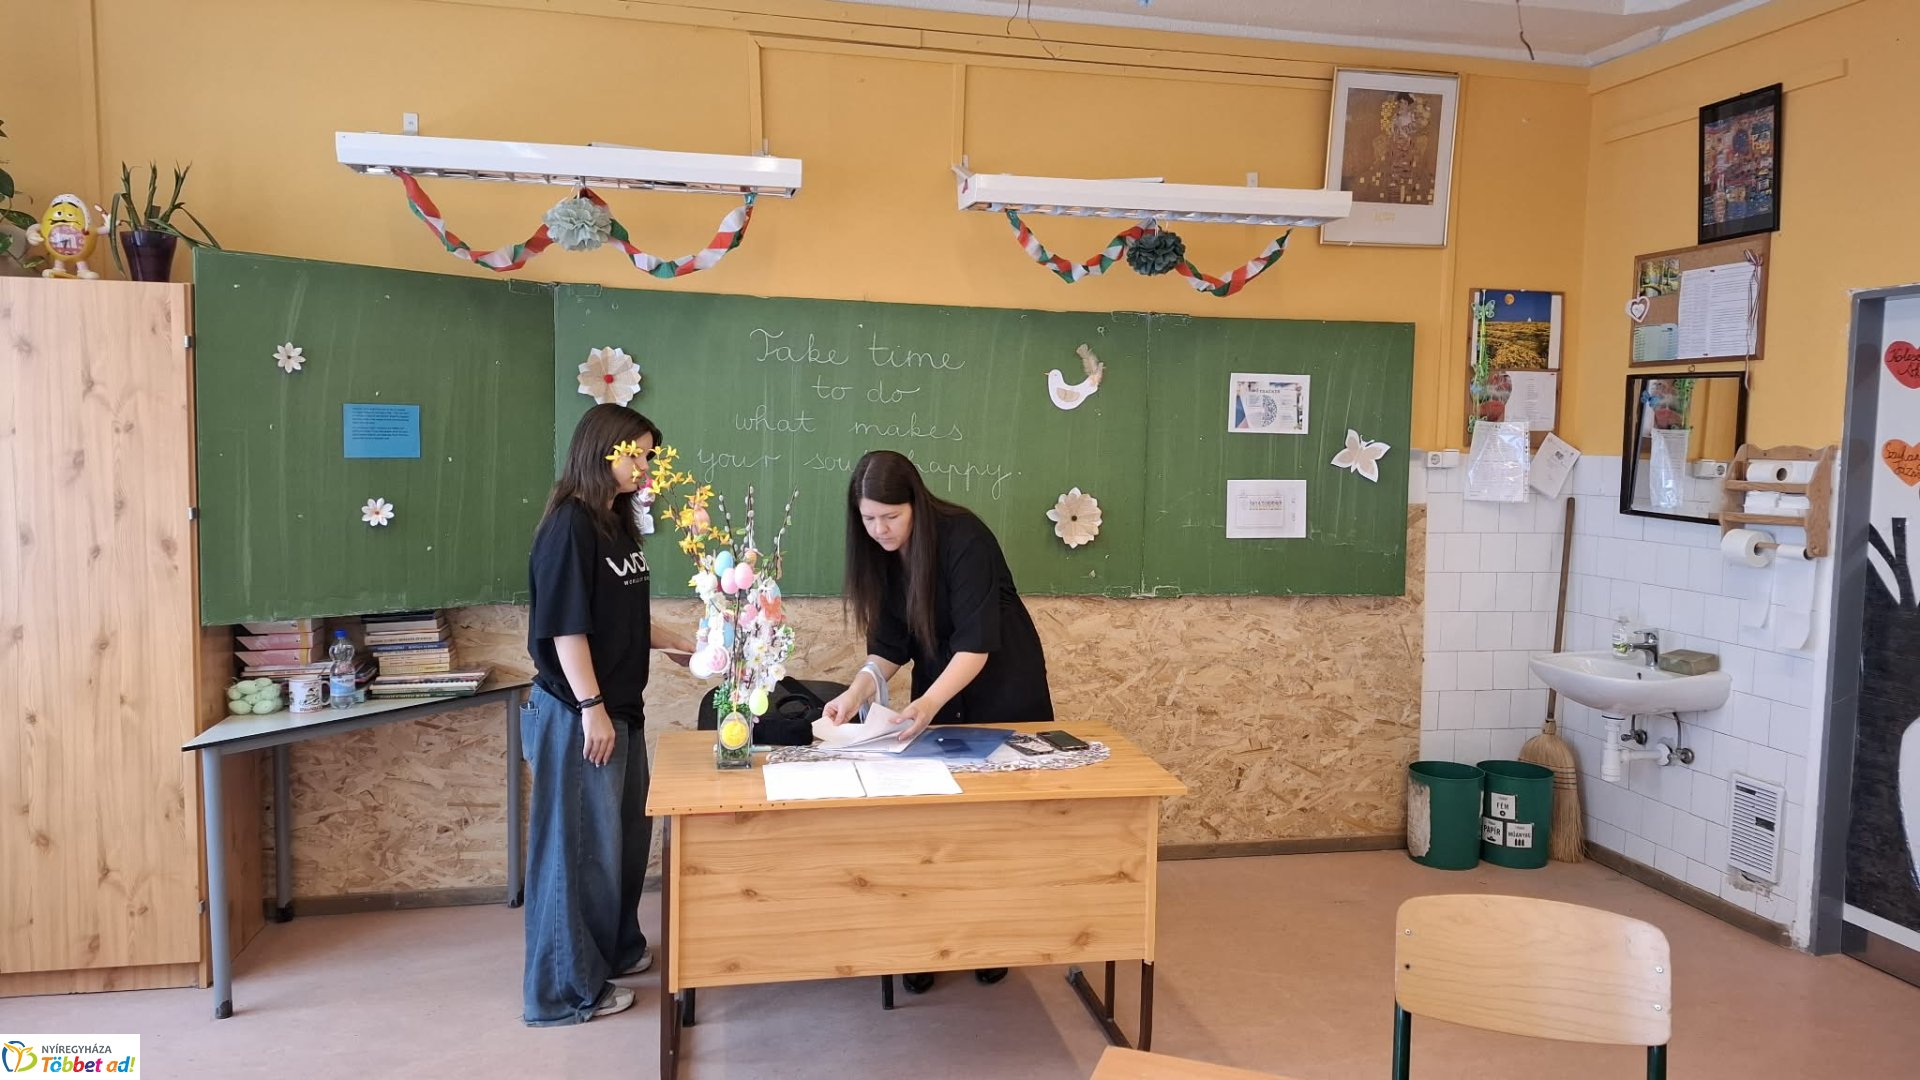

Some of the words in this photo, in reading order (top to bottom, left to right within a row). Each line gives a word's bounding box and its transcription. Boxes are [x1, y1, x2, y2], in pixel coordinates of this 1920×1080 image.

[750, 328, 849, 366] Take
[868, 331, 966, 370] time
[811, 374, 854, 400] to
[866, 379, 920, 404] do
[735, 404, 816, 433] what
[849, 412, 963, 441] makes
[697, 447, 782, 484] your
[803, 450, 853, 472] sou
[1484, 825, 1500, 836] PAPÍR
